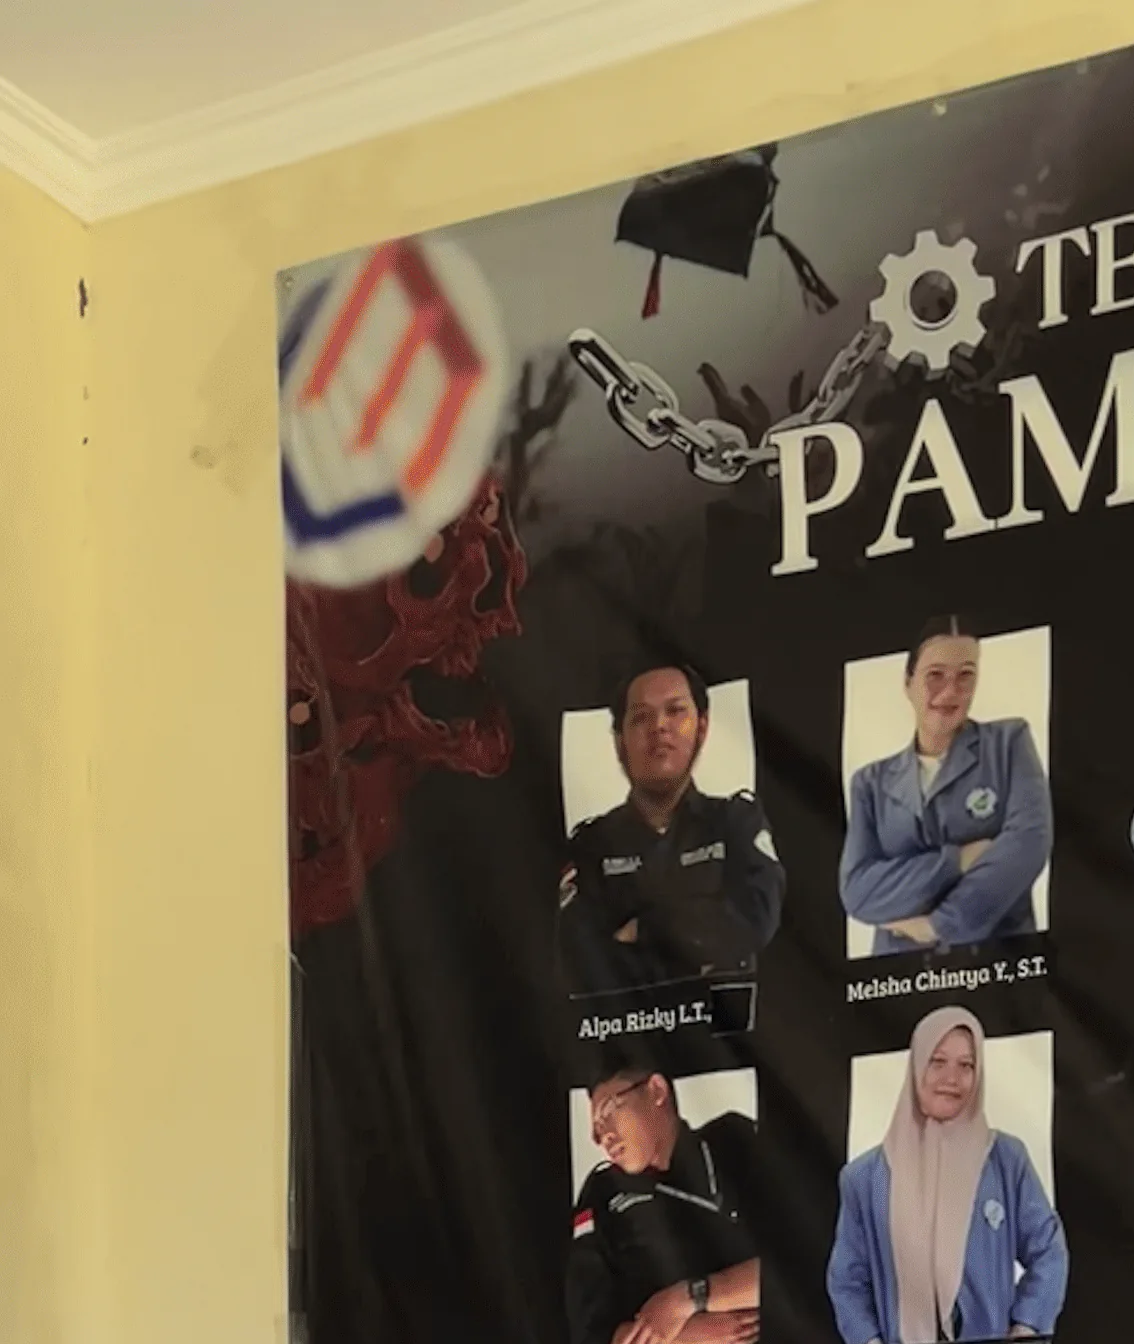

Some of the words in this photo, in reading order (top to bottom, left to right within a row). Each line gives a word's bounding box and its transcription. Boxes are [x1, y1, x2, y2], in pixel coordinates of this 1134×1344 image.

[915, 967, 991, 992] Chintya
[1016, 955, 1048, 978] S.T.
[578, 1016, 623, 1041] Alpa
[625, 1006, 676, 1032] Rizky
